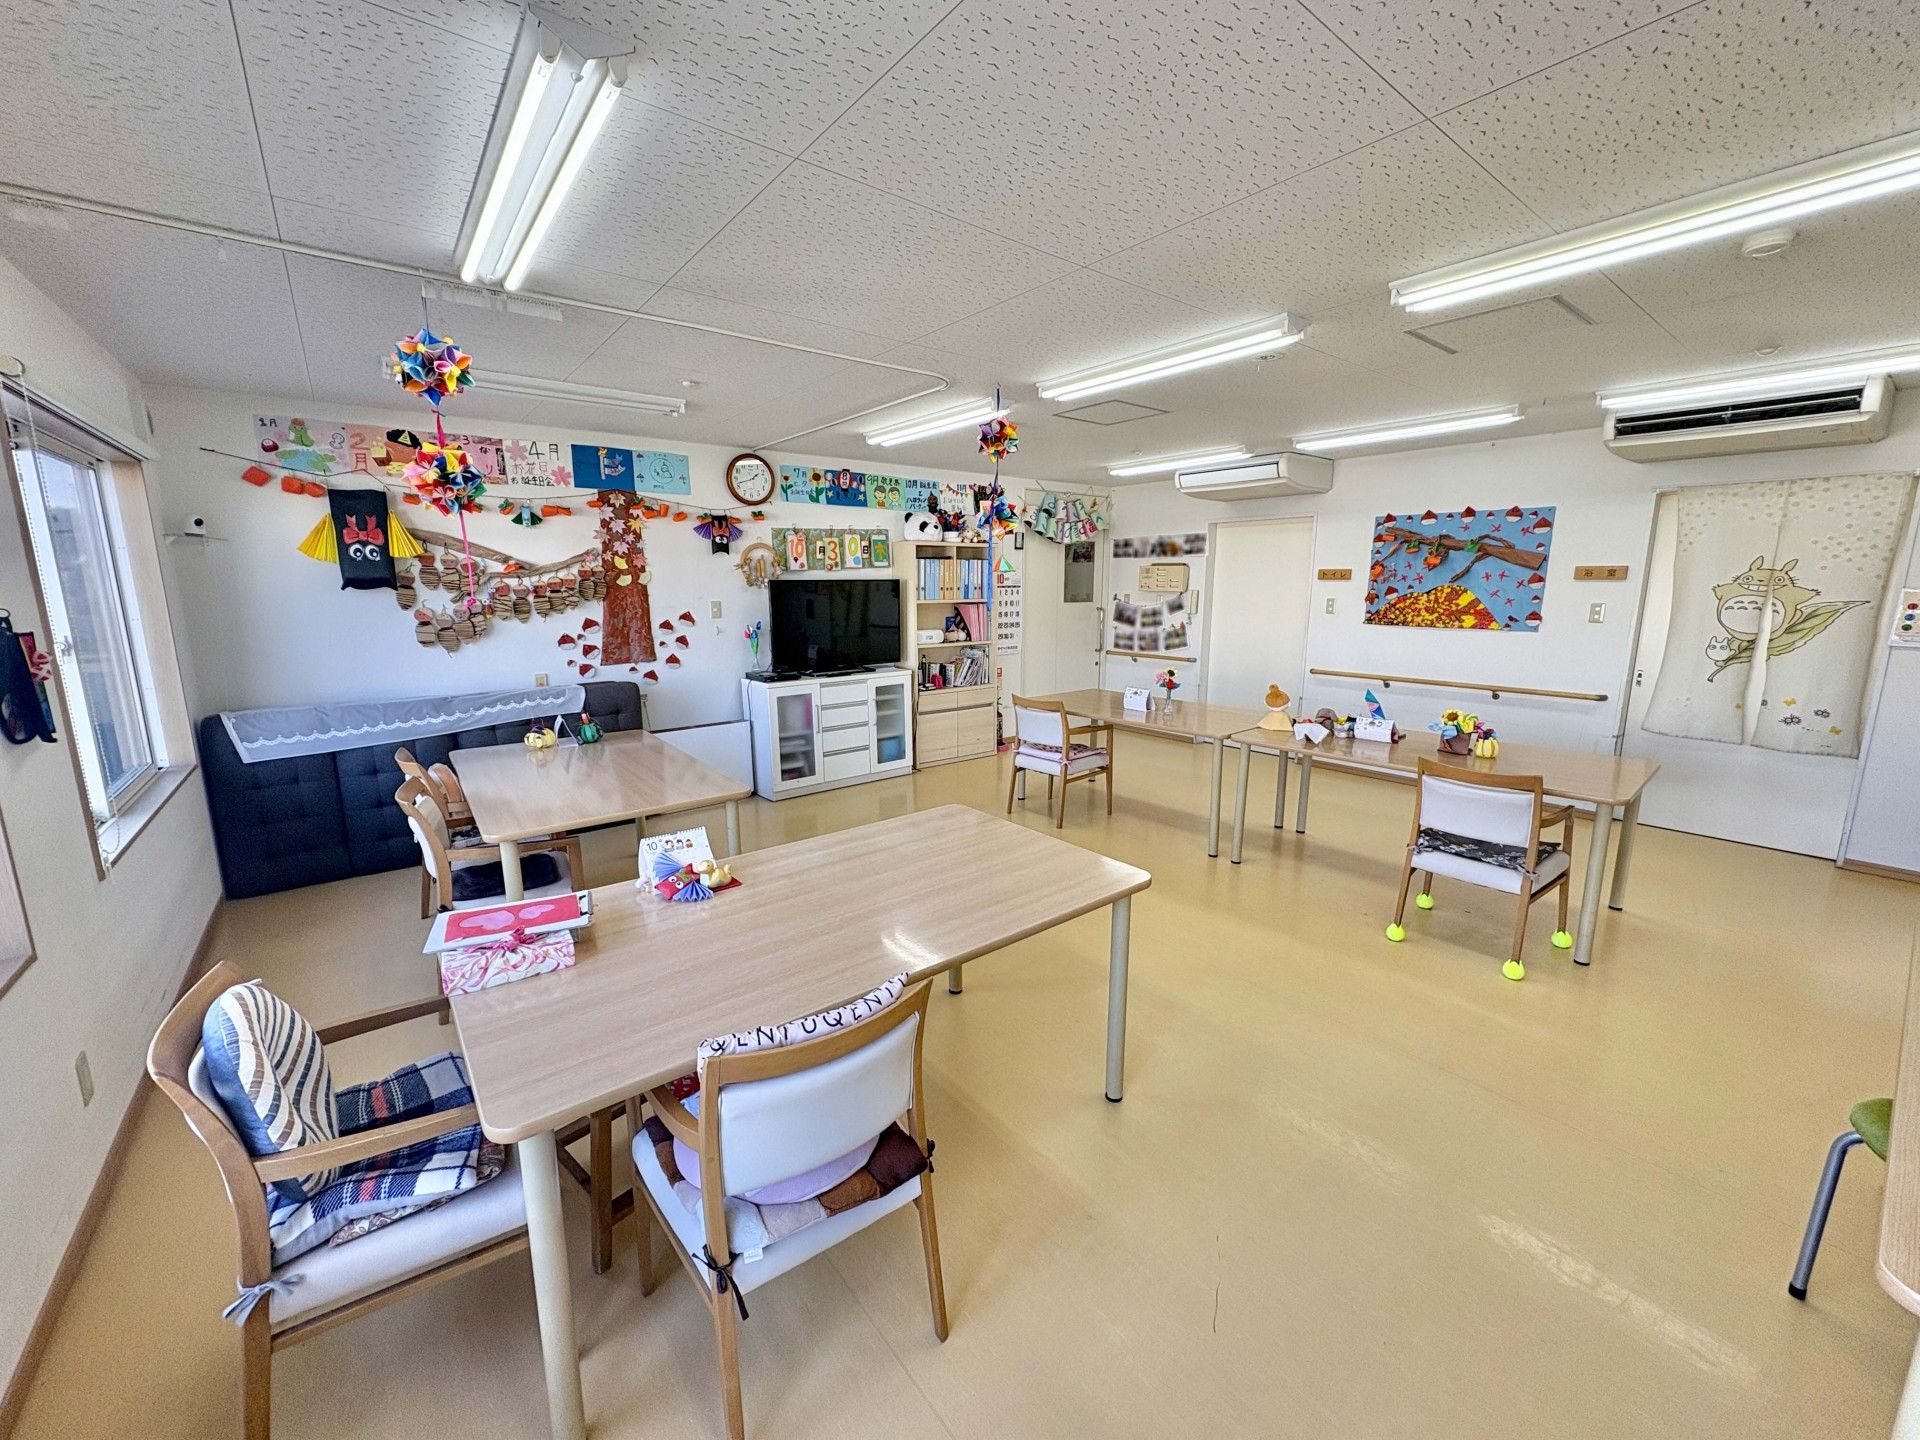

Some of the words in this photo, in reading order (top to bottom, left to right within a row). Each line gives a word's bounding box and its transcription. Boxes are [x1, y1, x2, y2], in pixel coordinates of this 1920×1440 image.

[528, 441, 559, 461] 4月
[512, 461, 548, 475] お花見
[997, 573, 1004, 584] 10
[647, 841, 658, 851] 10
